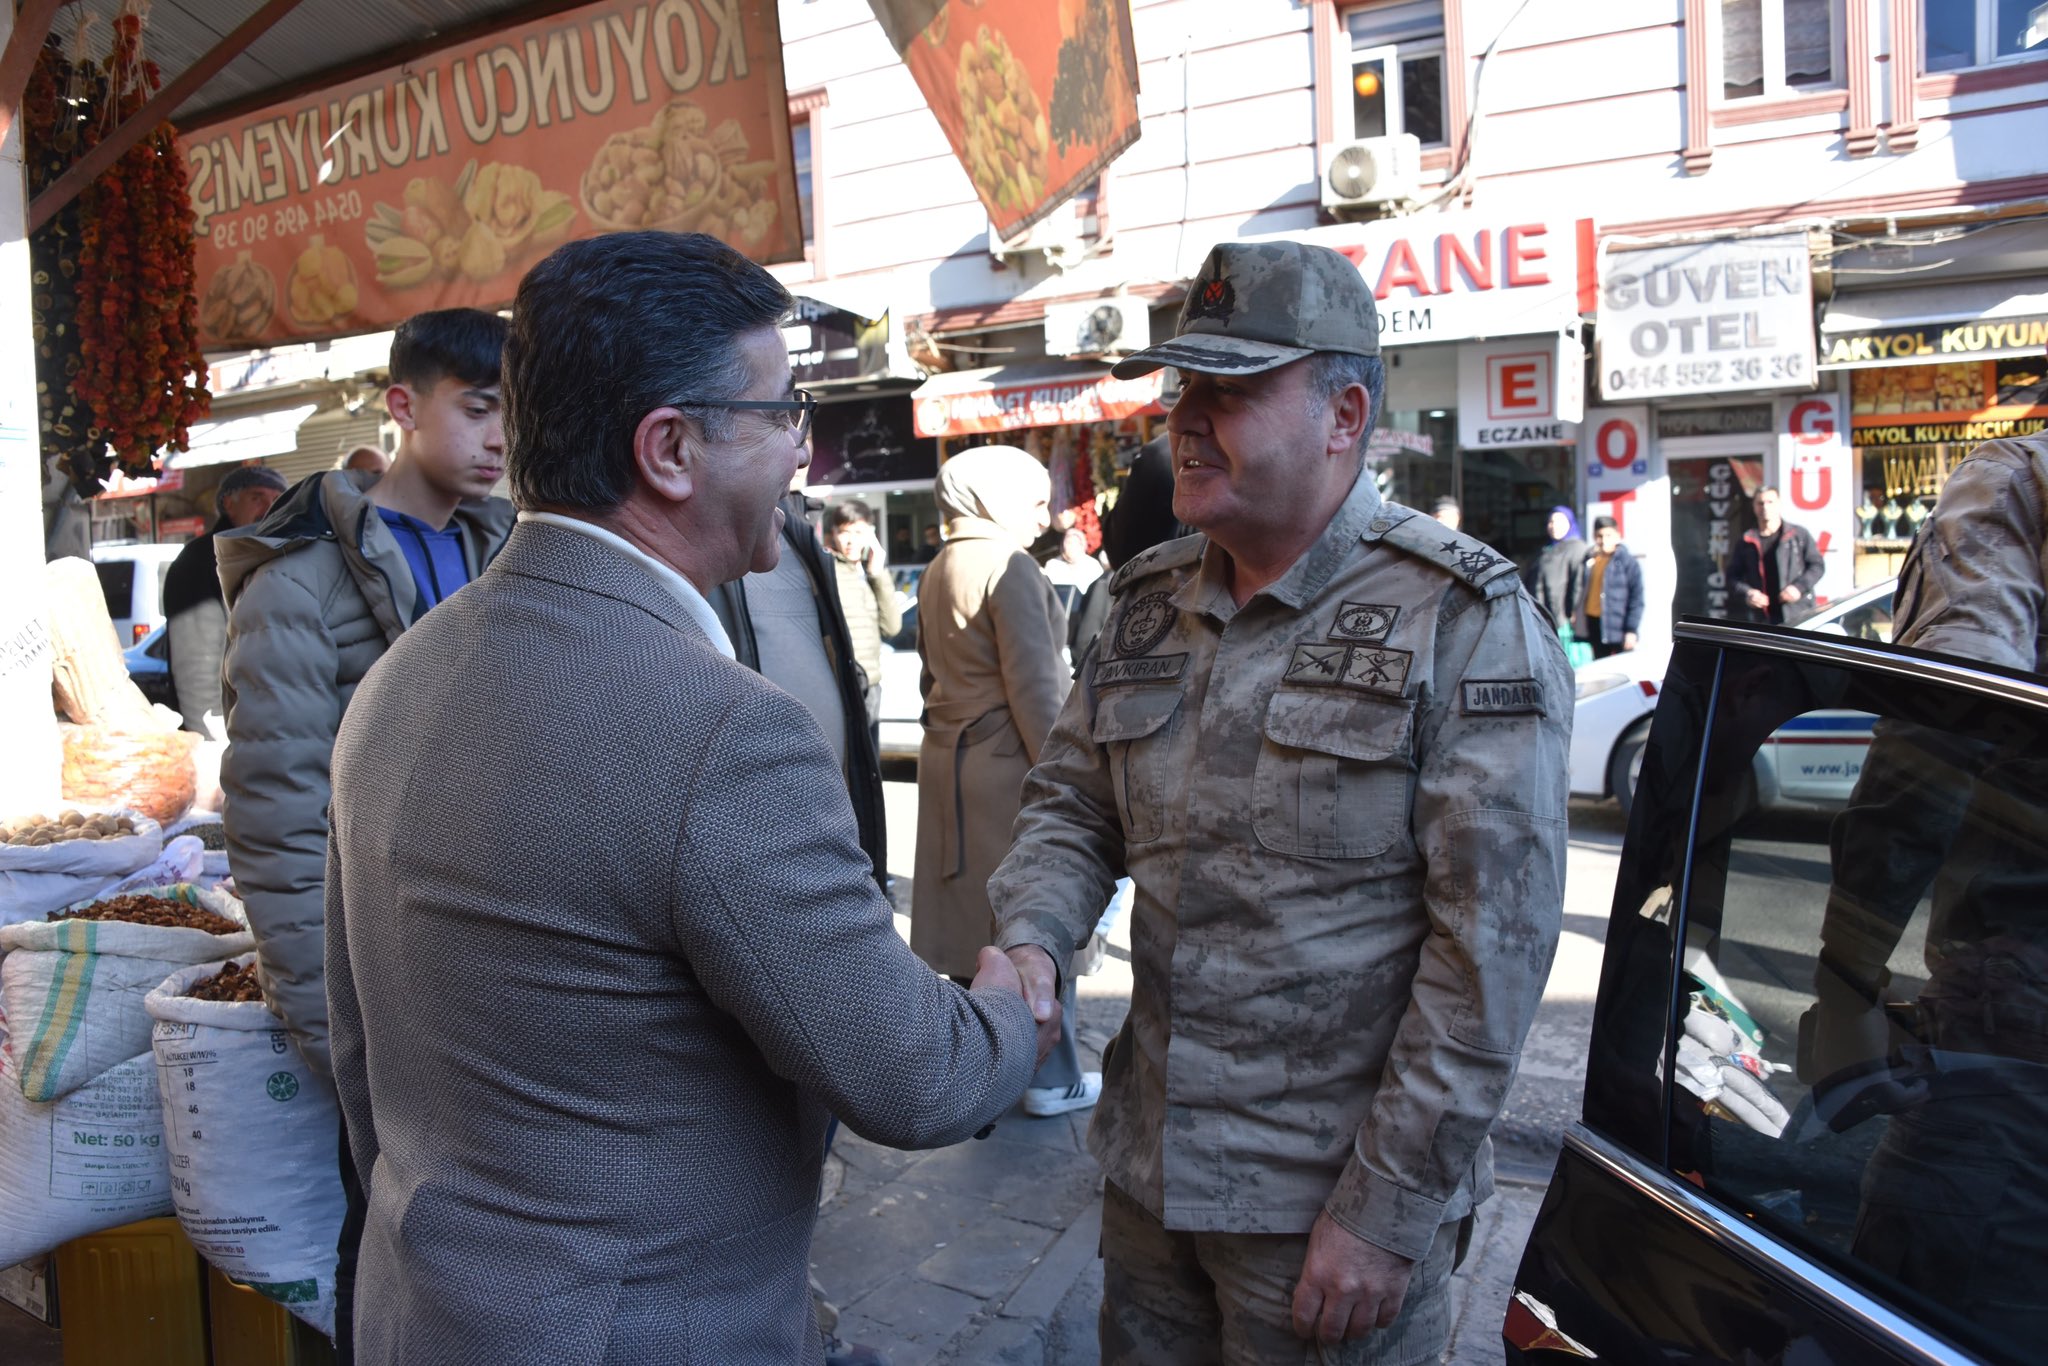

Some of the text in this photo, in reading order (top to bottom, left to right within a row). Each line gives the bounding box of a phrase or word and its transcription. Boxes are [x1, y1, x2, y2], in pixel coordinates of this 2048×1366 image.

[1604, 256, 1803, 312] GÜVEN
[1629, 310, 1777, 359] OTEL
[1829, 332, 1935, 364] AKYOL
[1675, 358, 1724, 387] 552
[1729, 356, 1763, 382] 36
[1478, 424, 1564, 445] ECZANE
[1851, 426, 1912, 446] AKYOL
[1103, 660, 1172, 681] AVKIRAN
[183, 1067, 195, 1078] 18
[185, 1081, 196, 1092] 18
[187, 1104, 199, 1115] 46
[73, 1131, 160, 1148] Net: 50 kg
[191, 1129, 202, 1140] 40
[231, 1225, 258, 1236] tavsiye
[258, 1224, 282, 1233] edilir.
